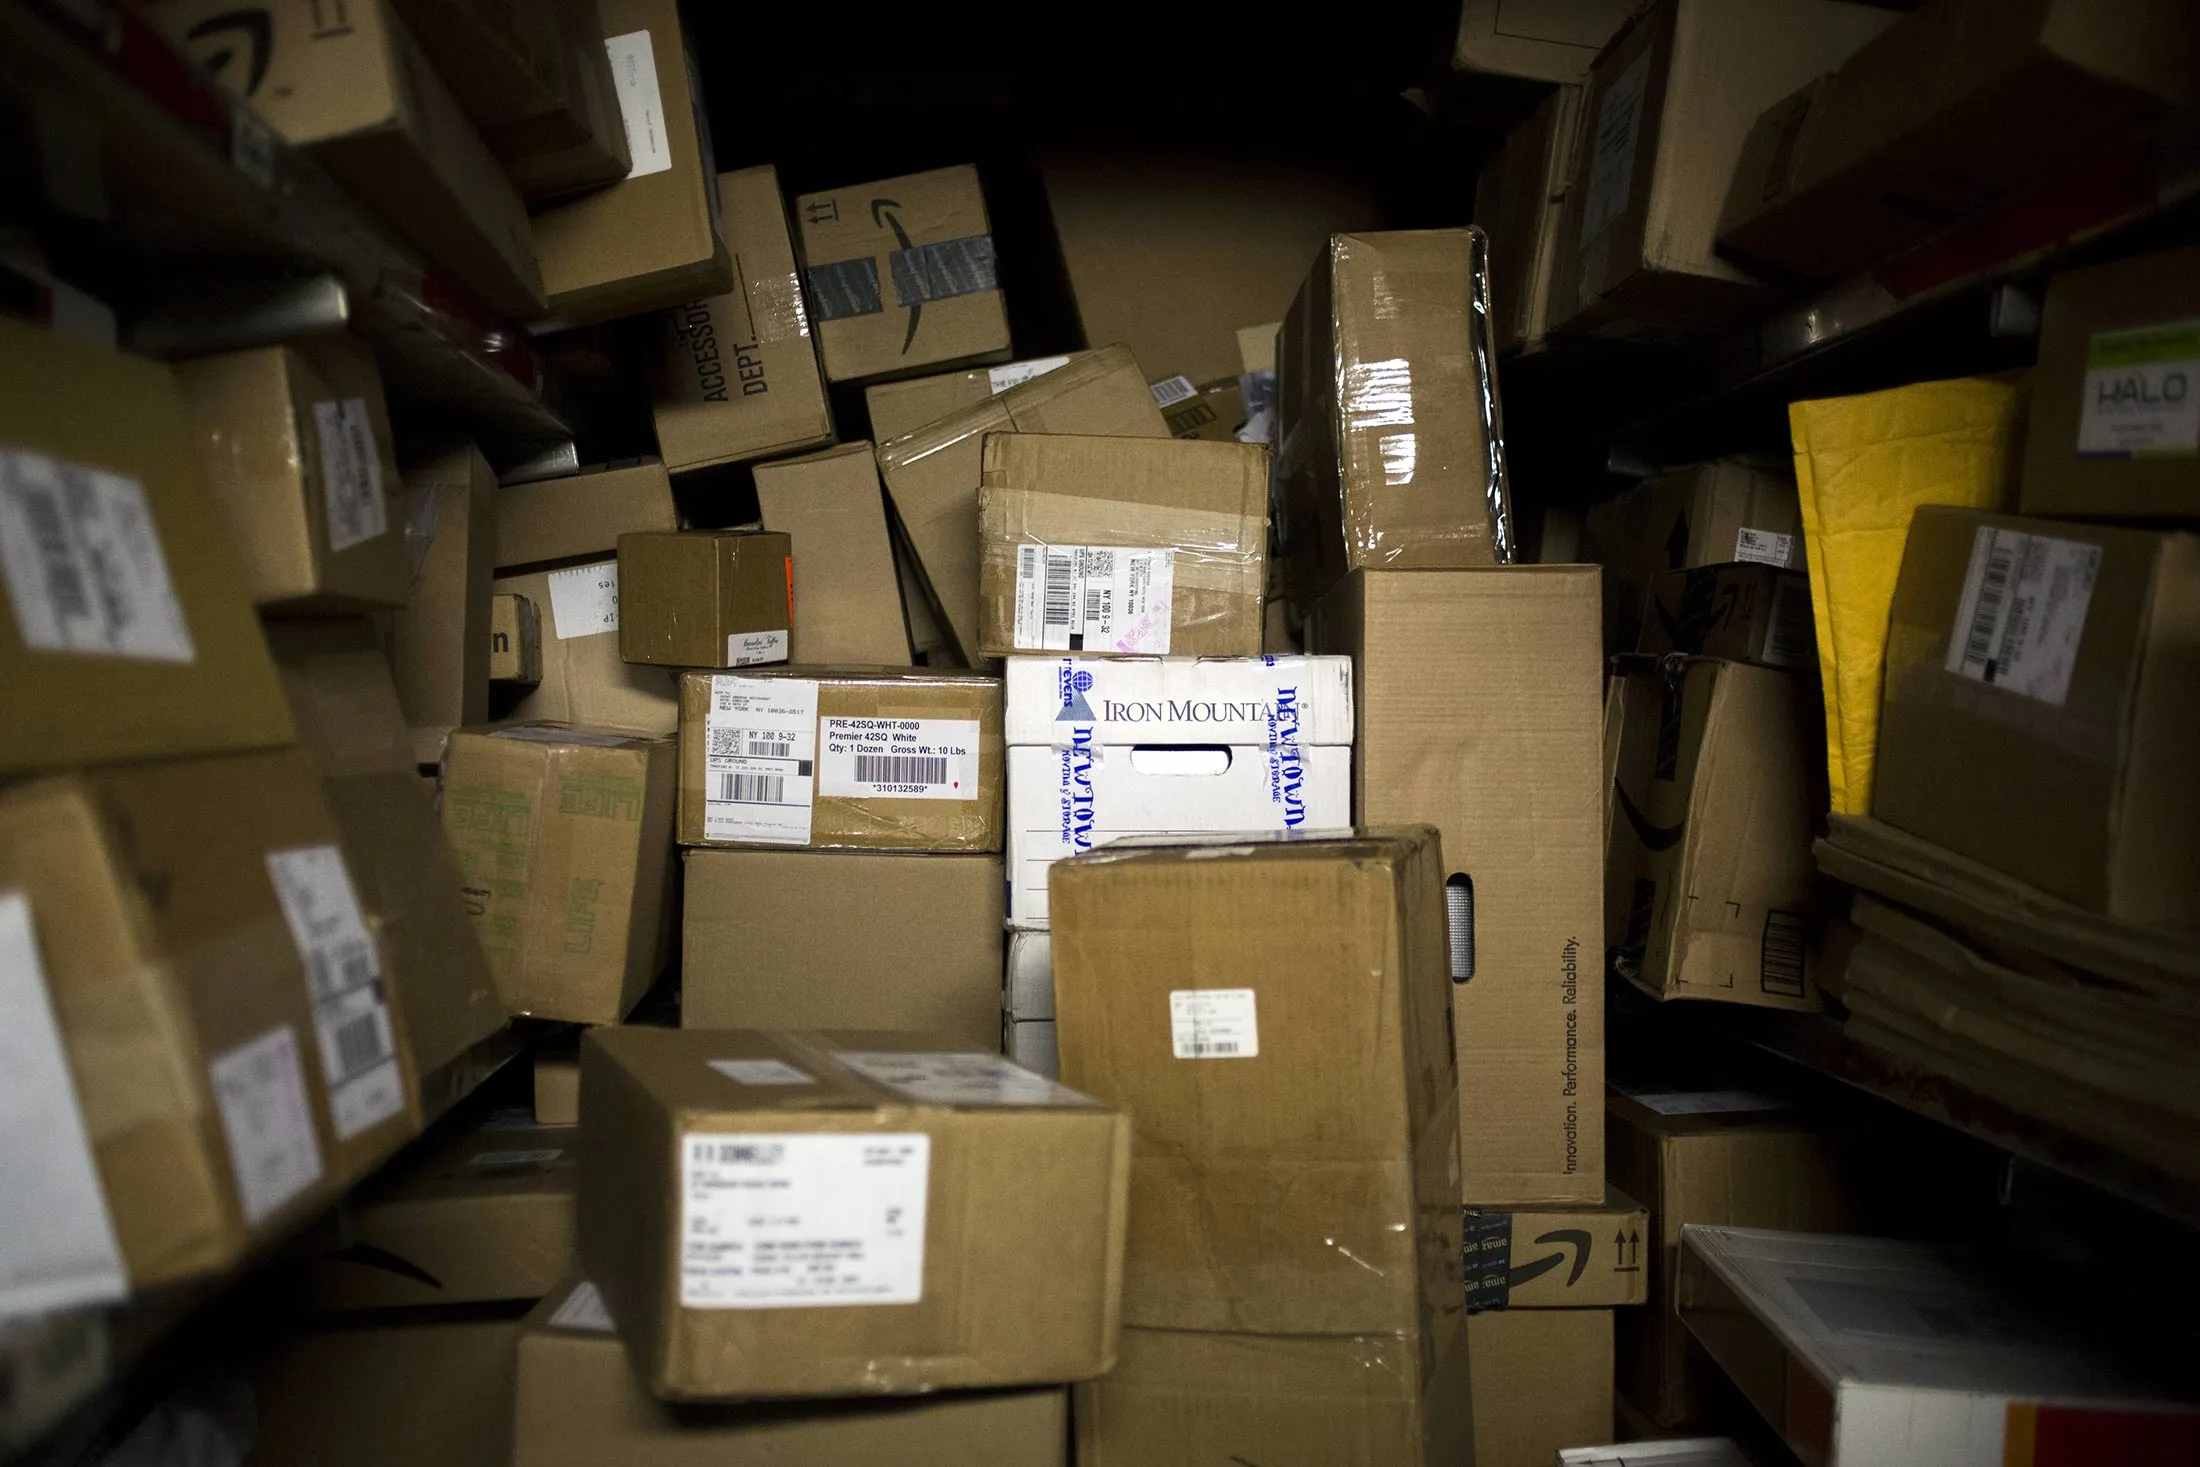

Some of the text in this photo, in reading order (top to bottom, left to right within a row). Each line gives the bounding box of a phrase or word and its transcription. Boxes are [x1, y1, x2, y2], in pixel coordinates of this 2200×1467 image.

[2098, 372, 2188, 404] HALO
[1128, 589, 1134, 597] NY
[1101, 590, 1112, 634] NY 100 9-32
[493, 632, 509, 653] n
[1103, 700, 1162, 723] IRON
[748, 731, 796, 742] NY 100 9-32
[829, 719, 920, 731] PRE-42SQ-WHT-0000
[829, 731, 917, 743] Premier 42SQ White
[828, 743, 967, 756] Qty: 1 Dozen Gross Wt.: 10 Lbs
[1277, 686, 1306, 830] NEWTOWN
[1269, 758, 1282, 803] STORAGE
[1062, 797, 1071, 844] STORAGE
[1562, 936, 1580, 1175] Innovation. Performance. Reliability.
